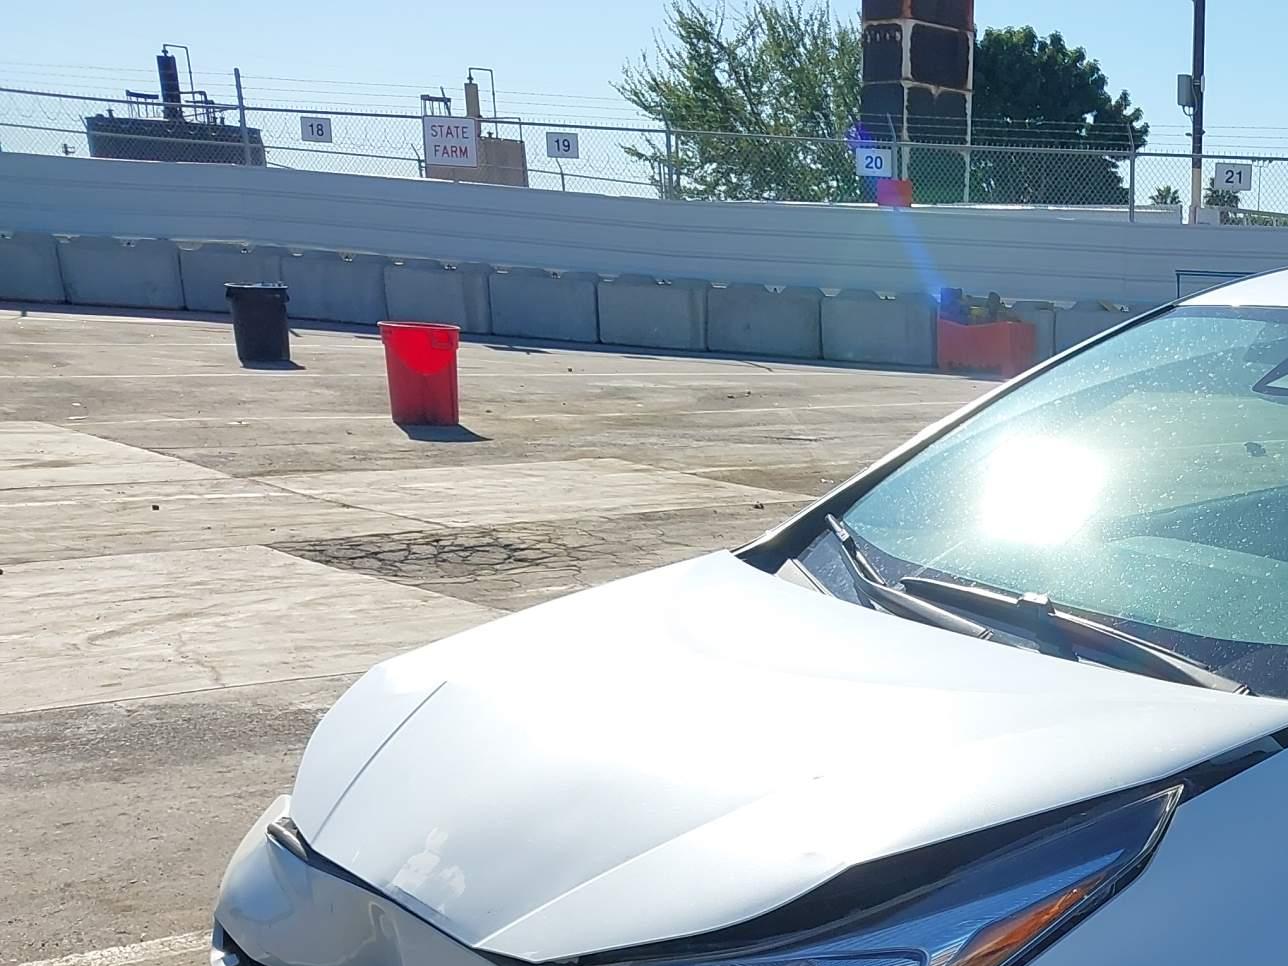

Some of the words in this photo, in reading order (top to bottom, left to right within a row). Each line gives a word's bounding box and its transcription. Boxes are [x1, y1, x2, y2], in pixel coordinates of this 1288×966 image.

[308, 123, 324, 136] 18
[431, 125, 470, 139] STATE
[434, 145, 469, 158] FARM
[554, 139, 570, 152] 19
[864, 155, 883, 170] 20
[1225, 169, 1242, 184] 21
